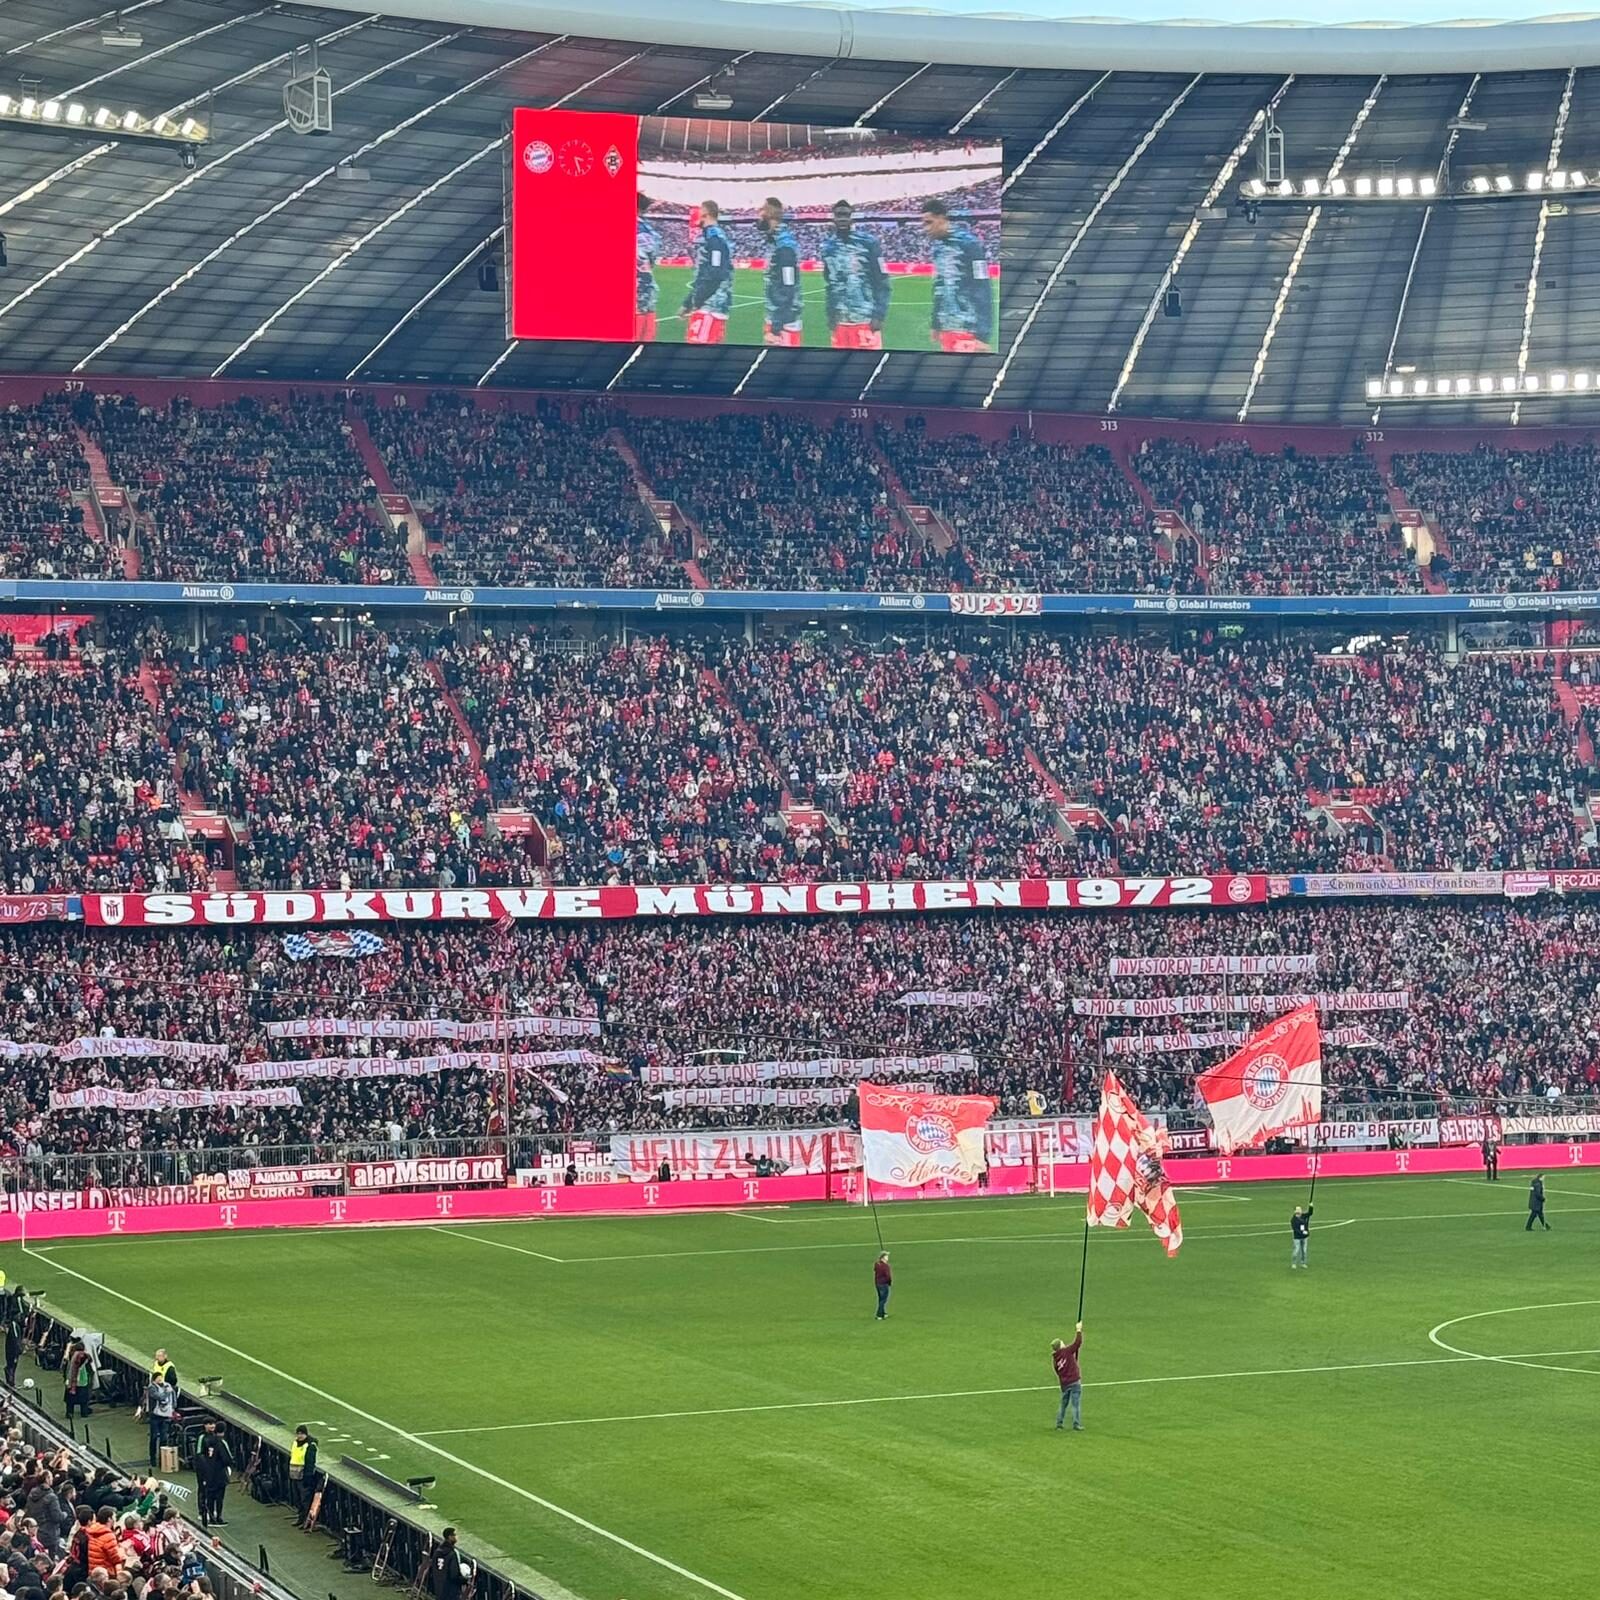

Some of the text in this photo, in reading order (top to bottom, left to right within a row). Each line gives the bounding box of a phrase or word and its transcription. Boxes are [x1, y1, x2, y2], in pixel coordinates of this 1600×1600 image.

[850, 408, 868, 419] 314
[1100, 421, 1118, 431] 313
[1366, 432, 1384, 442] 312
[182, 587, 219, 598] Allianz
[424, 590, 459, 601] Allianz
[655, 593, 689, 605] Allianz
[878, 596, 911, 607] Allianz
[1469, 595, 1598, 608] Allianz Global Investors
[950, 593, 1038, 614] SUPS 94
[1133, 599, 1251, 610] Allianz Global Investors
[1554, 874, 1578, 886] BFC
[143, 889, 602, 924] SÜDKURVE
[635, 881, 1022, 914] MÜNCHEN
[1046, 878, 1213, 906] 1972
[1117, 957, 1233, 975] INVESTOREN-DEAL
[1240, 957, 1261, 972] MIT
[1265, 957, 1291, 972] CVC
[1078, 1001, 1087, 1014] 3
[1134, 999, 1177, 1015] BONUS
[1211, 996, 1235, 1011] DEN
[1241, 995, 1303, 1011] LIGA-BOSS
[1326, 993, 1401, 1009] FRANKREICH
[269, 1021, 303, 1038] CVC
[322, 1019, 440, 1038] BLACKSTONE
[1163, 1034, 1193, 1050] BONI
[240, 1059, 350, 1080] SAUDISCHES
[650, 1063, 764, 1084] BLACKSTONE
[778, 1061, 808, 1077] GUT
[673, 1088, 766, 1106] SCHLECHT
[1313, 1123, 1356, 1139] ADLER
[1440, 1118, 1485, 1143] SELTERS
[1395, 1152, 1410, 1171] T
[1569, 1145, 1583, 1164] T
[472, 1158, 504, 1180] rot
[1217, 1160, 1231, 1178] T
[1306, 1156, 1321, 1175] T
[644, 1185, 660, 1205] T
[743, 1181, 759, 1200] T
[841, 1176, 857, 1195] T
[436, 1195, 452, 1215] T
[541, 1189, 557, 1209] T
[220, 1205, 237, 1226] T
[329, 1200, 346, 1220] T
[108, 1211, 125, 1231] T
